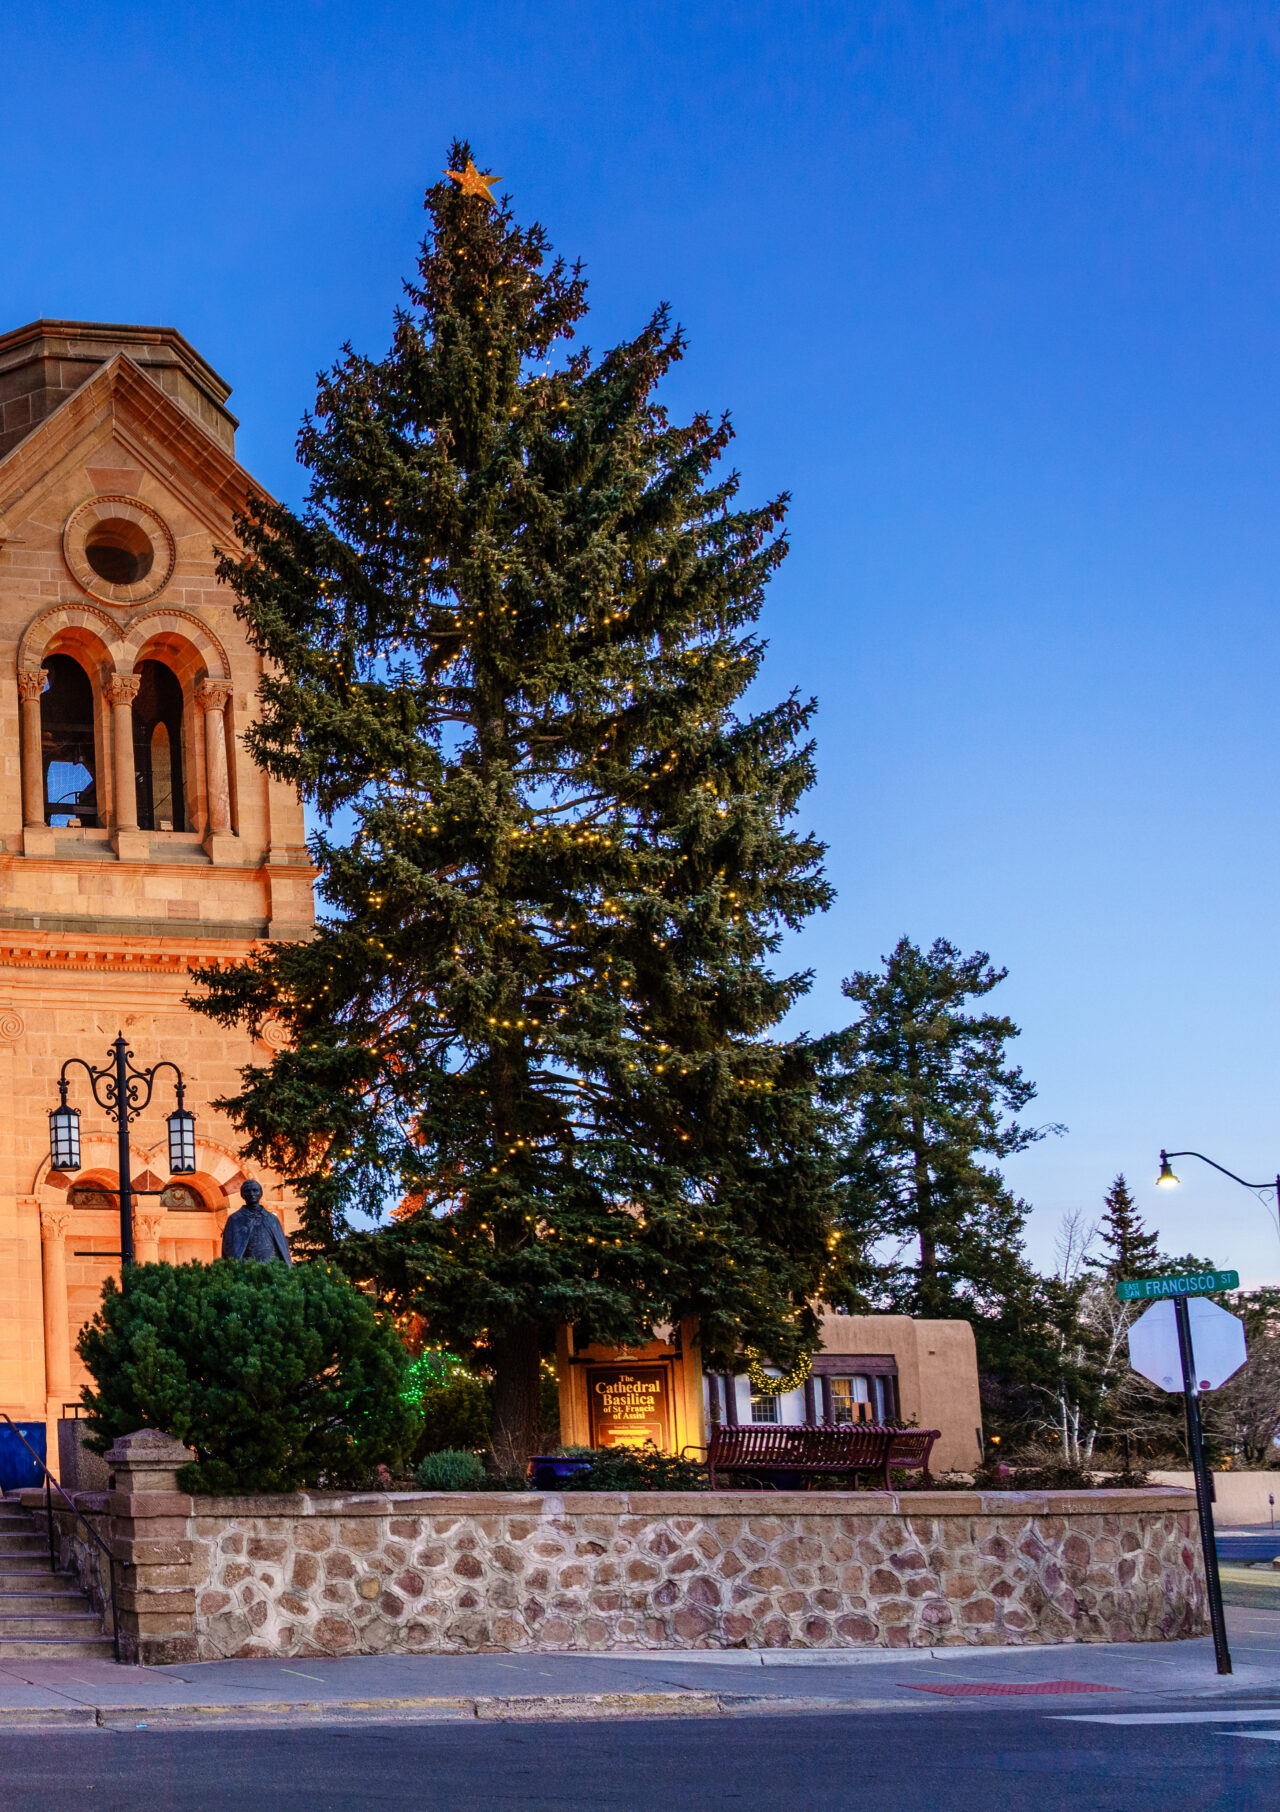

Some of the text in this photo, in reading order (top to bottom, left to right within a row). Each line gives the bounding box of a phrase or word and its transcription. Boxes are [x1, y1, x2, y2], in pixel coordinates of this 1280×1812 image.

[1124, 1283, 1139, 1291] EAST
[1145, 1273, 1232, 1295] FRANCISCO ST
[1125, 1290, 1140, 1298] SAN
[595, 1380, 660, 1393] Cathedral
[603, 1393, 655, 1406] Basilica
[623, 1412, 646, 1420] Assisi
